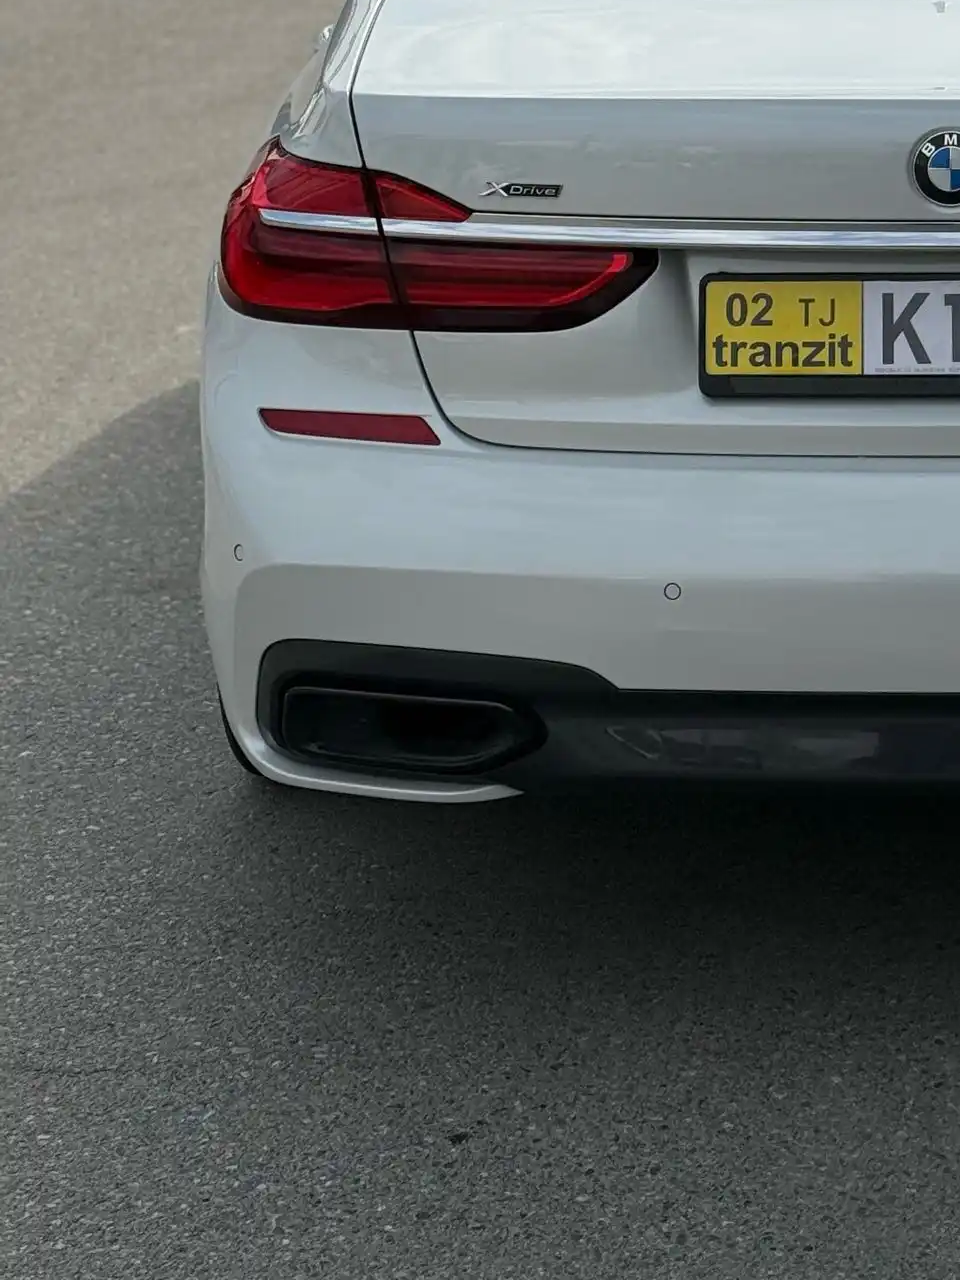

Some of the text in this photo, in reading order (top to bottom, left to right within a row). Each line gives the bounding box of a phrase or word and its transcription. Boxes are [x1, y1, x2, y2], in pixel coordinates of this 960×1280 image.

[726, 293, 836, 327] 02 TJ
[712, 333, 854, 368] tranzit
